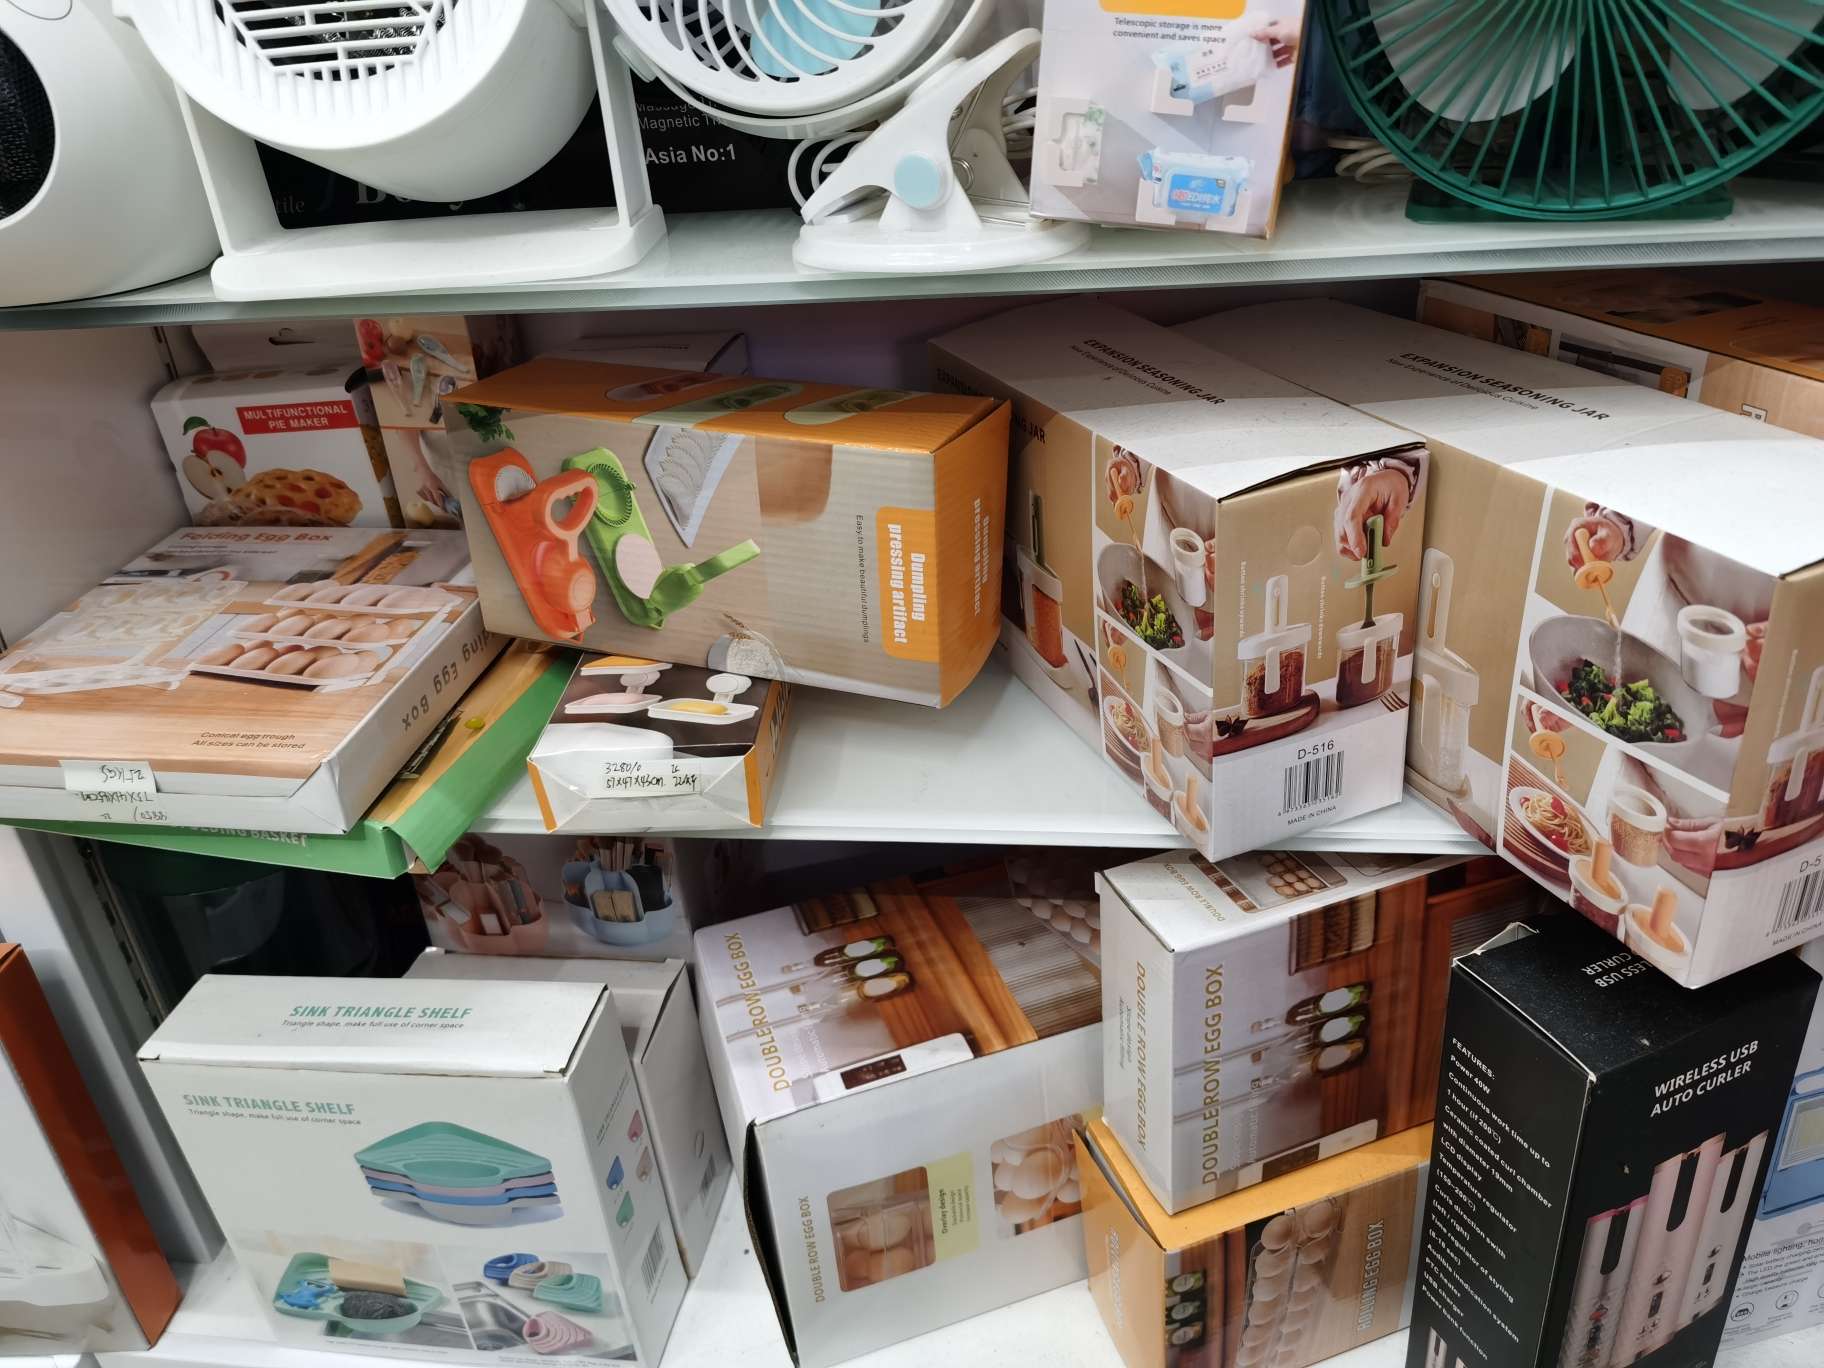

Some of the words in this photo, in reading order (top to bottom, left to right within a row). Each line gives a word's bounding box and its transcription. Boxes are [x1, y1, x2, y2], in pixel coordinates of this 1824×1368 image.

[1113, 30, 1158, 39] convenient
[1160, 32, 1176, 40] and
[1178, 34, 1201, 42] saves
[1202, 36, 1226, 44] space
[1115, 17, 1157, 28] Telescopic
[1158, 21, 1190, 30] storage
[645, 146, 688, 165] Asia
[691, 144, 736, 162] No:1
[1084, 339, 1141, 367] EXPANSION
[1136, 364, 1202, 395] SEASONING
[1197, 394, 1226, 406] JAR
[1400, 352, 1486, 383] EXPANSION
[1481, 378, 1575, 409] SEASONING
[1571, 406, 1610, 420] JAR
[243, 404, 348, 420] MULTIFUNCTIONAL
[268, 420, 286, 429] PIE
[288, 417, 329, 428] MAKER
[180, 532, 249, 542] Folding
[253, 532, 292, 542] Egg
[294, 532, 334, 541] Box
[856, 514, 864, 535] Easy
[858, 536, 863, 545] to
[888, 524, 905, 589] pressing
[910, 553, 926, 622] Dumpling
[861, 607, 869, 643] dumplings
[892, 591, 908, 643] artifact
[432, 662, 458, 696] Egg
[402, 694, 430, 732] Box
[1297, 740, 1334, 760] D-516
[1288, 815, 1306, 825] MADE
[1316, 805, 1336, 816] CHINA
[250, 830, 308, 848] BASKET
[724, 932, 746, 960] BOX
[734, 961, 757, 989] EGG
[1581, 952, 1632, 976] CURLER
[1594, 971, 1623, 988] USB
[1136, 960, 1146, 1036] DOUBLE
[1205, 964, 1224, 1009] BOX
[281, 1020, 314, 1028] Triangle
[290, 1006, 331, 1017] SINK
[334, 1006, 416, 1018] TRIANGLE
[417, 1007, 472, 1019] SHELF
[744, 991, 769, 1027] ROW
[1205, 1011, 1221, 1054] EGG
[756, 1027, 792, 1092] DOUBLE
[1136, 1038, 1146, 1078] ROW
[1451, 1054, 1473, 1079] Power
[1474, 1078, 1491, 1094] 40W
[1452, 1038, 1496, 1080] FEATURES:
[1654, 1054, 1726, 1098] WIRELESS
[1730, 1040, 1759, 1062] USB
[1136, 1078, 1146, 1119] EGG
[1203, 1058, 1221, 1105] ROW
[1651, 1089, 1693, 1118] AUTO
[1696, 1061, 1752, 1096] CURLER
[182, 1094, 222, 1107] SINK
[222, 1096, 302, 1112] TRIANGLE
[304, 1101, 356, 1115] SHELF
[188, 1109, 220, 1118] Triangle
[338, 1118, 362, 1126] space
[1448, 1072, 1491, 1114] Continuous
[1491, 1112, 1510, 1132] work
[1511, 1130, 1528, 1149] time
[1530, 1146, 1540, 1160] up
[1542, 1157, 1551, 1168] to
[1452, 1093, 1469, 1112] hour
[1470, 1110, 1479, 1119] (if
[1136, 1119, 1146, 1150] BOX
[1202, 1105, 1219, 1185] DOUBLE
[1440, 1136, 1456, 1154] LCD
[1456, 1153, 1482, 1181] display
[1442, 1122, 1458, 1139] with
[1458, 1137, 1490, 1170] diameter
[1491, 1168, 1513, 1192] 19mm
[1445, 1105, 1474, 1136] Ceramic
[1475, 1134, 1500, 1160] coated
[1500, 1158, 1516, 1176] curl
[1517, 1174, 1552, 1208] chamber
[798, 1195, 812, 1218] BOX
[1439, 1153, 1482, 1198] Temperature
[1482, 1198, 1517, 1233] regulator
[1435, 1184, 1452, 1204] Curls
[1453, 1204, 1485, 1238] direction
[802, 1219, 815, 1239] EGG
[1368, 1219, 1384, 1249] BOX
[1450, 1218, 1470, 1241] right)
[806, 1240, 818, 1265] ROW
[1365, 1251, 1381, 1279] EGG
[1431, 1214, 1447, 1234] Time
[1448, 1233, 1479, 1267] regulator
[1480, 1266, 1488, 1275] of
[1489, 1274, 1514, 1303] styling
[809, 1265, 824, 1302] DOUBLE
[1424, 1271, 1438, 1289] USB
[1438, 1288, 1464, 1316] charger
[1492, 1313, 1519, 1343] system
